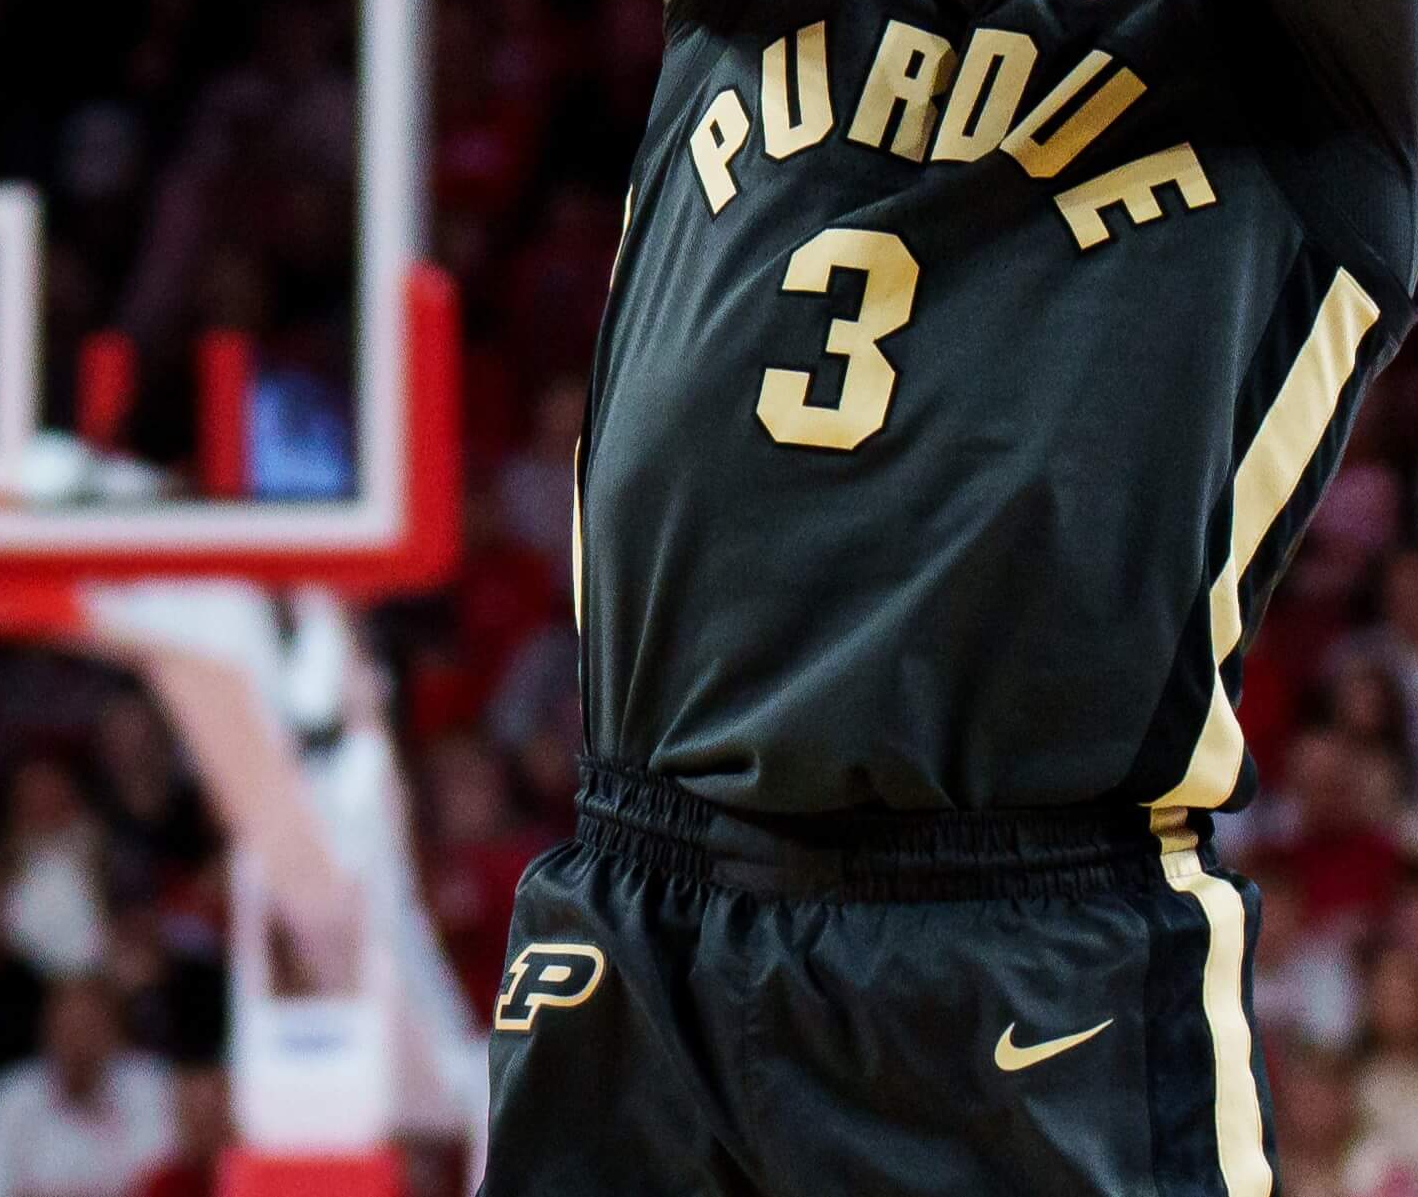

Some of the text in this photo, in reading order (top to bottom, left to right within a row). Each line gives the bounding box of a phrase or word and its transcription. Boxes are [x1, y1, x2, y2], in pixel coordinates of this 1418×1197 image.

[688, 18, 1218, 251] PURDUE
[755, 227, 920, 451] 3
[495, 942, 605, 1032] P
